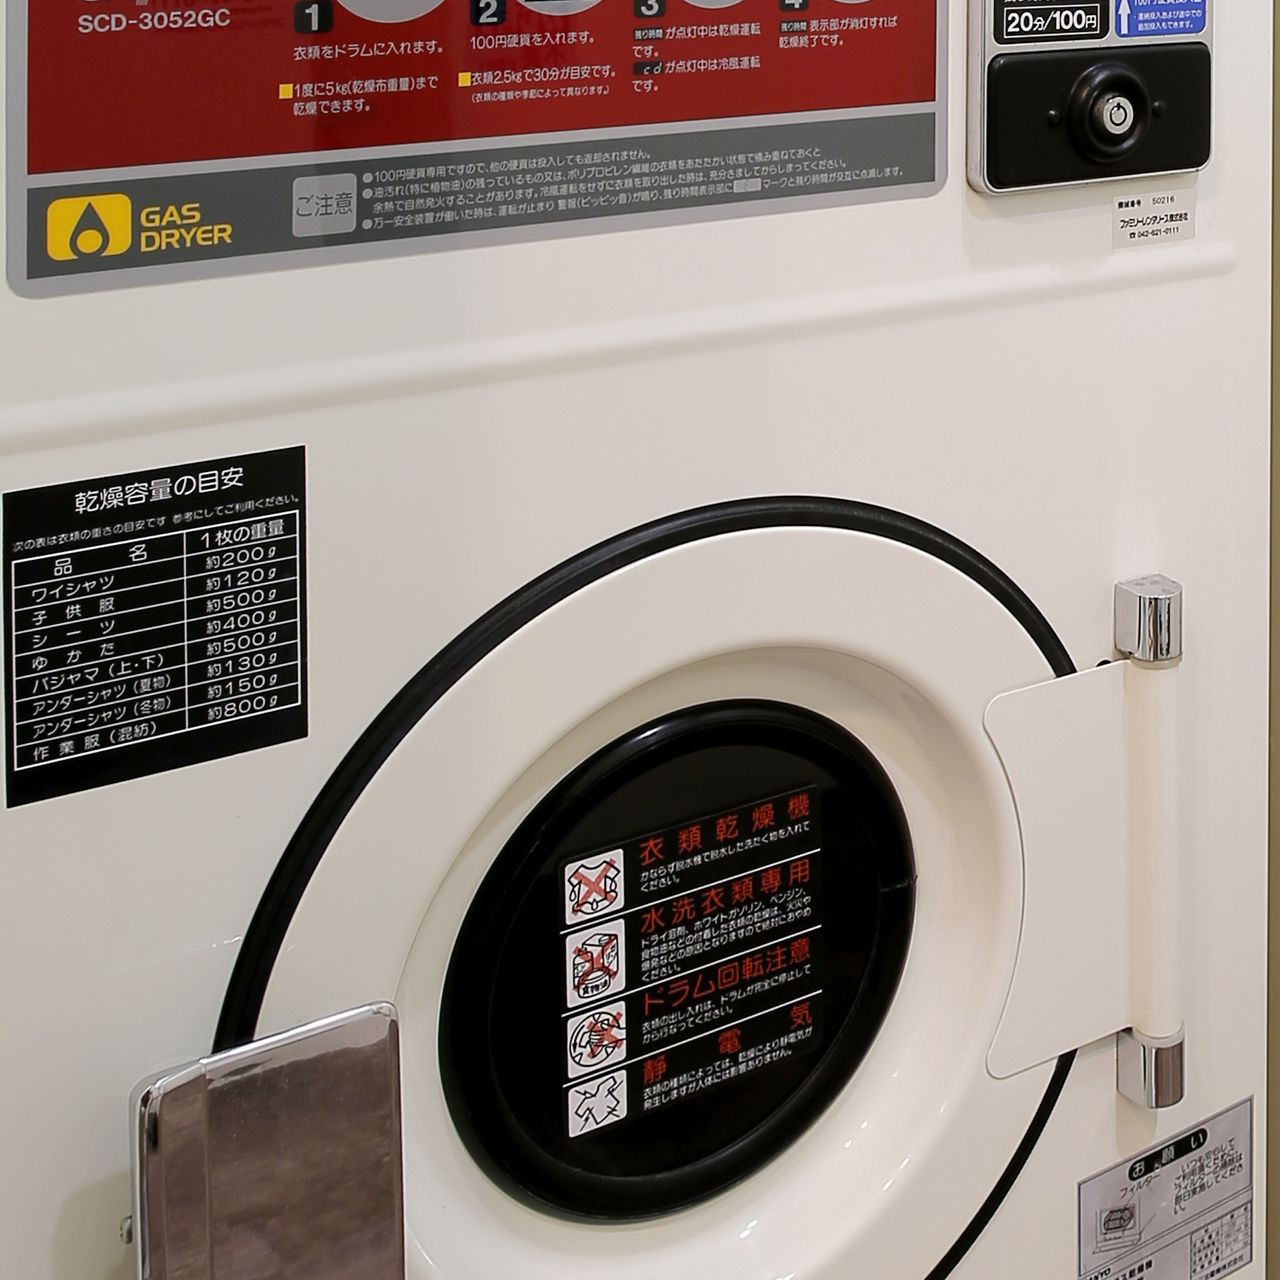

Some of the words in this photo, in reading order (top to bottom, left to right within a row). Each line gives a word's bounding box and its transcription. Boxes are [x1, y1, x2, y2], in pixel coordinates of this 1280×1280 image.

[78, 9, 231, 33] SCD-3052GC
[304, 4, 319, 31] 1
[809, 15, 898, 32] 表示部が消灯すれば
[1007, 9, 1097, 33] 20分/100円
[470, 31, 594, 49] 100円硬貨を入れます。
[665, 23, 761, 39] が点灯中は乾燥運転
[779, 34, 844, 49] 乾燥終了です。
[293, 40, 443, 61] 衣類をドラムに入れます。
[633, 46, 658, 58] です。
[665, 56, 761, 73] が点灯中は冷風運転
[633, 80, 658, 92] です。
[293, 99, 370, 116] 乾燥できます。
[140, 203, 201, 226] GAS
[296, 192, 353, 217] ご注意
[140, 224, 232, 252] DRYER
[75, 467, 244, 514] 乾燥容量の目安
[201, 519, 285, 549] 1枚の重量
[32, 576, 115, 603] ワイシャツ
[206, 545, 277, 569] 約200g
[206, 567, 277, 591] 約120g
[206, 588, 277, 612] 約500g
[206, 610, 277, 634] 約400g
[206, 631, 277, 656] 約500g
[206, 652, 277, 677] 約130g
[206, 673, 277, 699] 約150g
[206, 694, 277, 721] 約800g
[639, 793, 810, 866] 衣類乾燥機
[641, 875, 680, 892] ください。
[641, 859, 810, 933] 水洗衣類専用
[641, 964, 681, 982] ください。
[644, 937, 811, 1016] ドラム回転注意
[1133, 1132, 1204, 1178] お願い
[1120, 1173, 1160, 1199] フィルター
